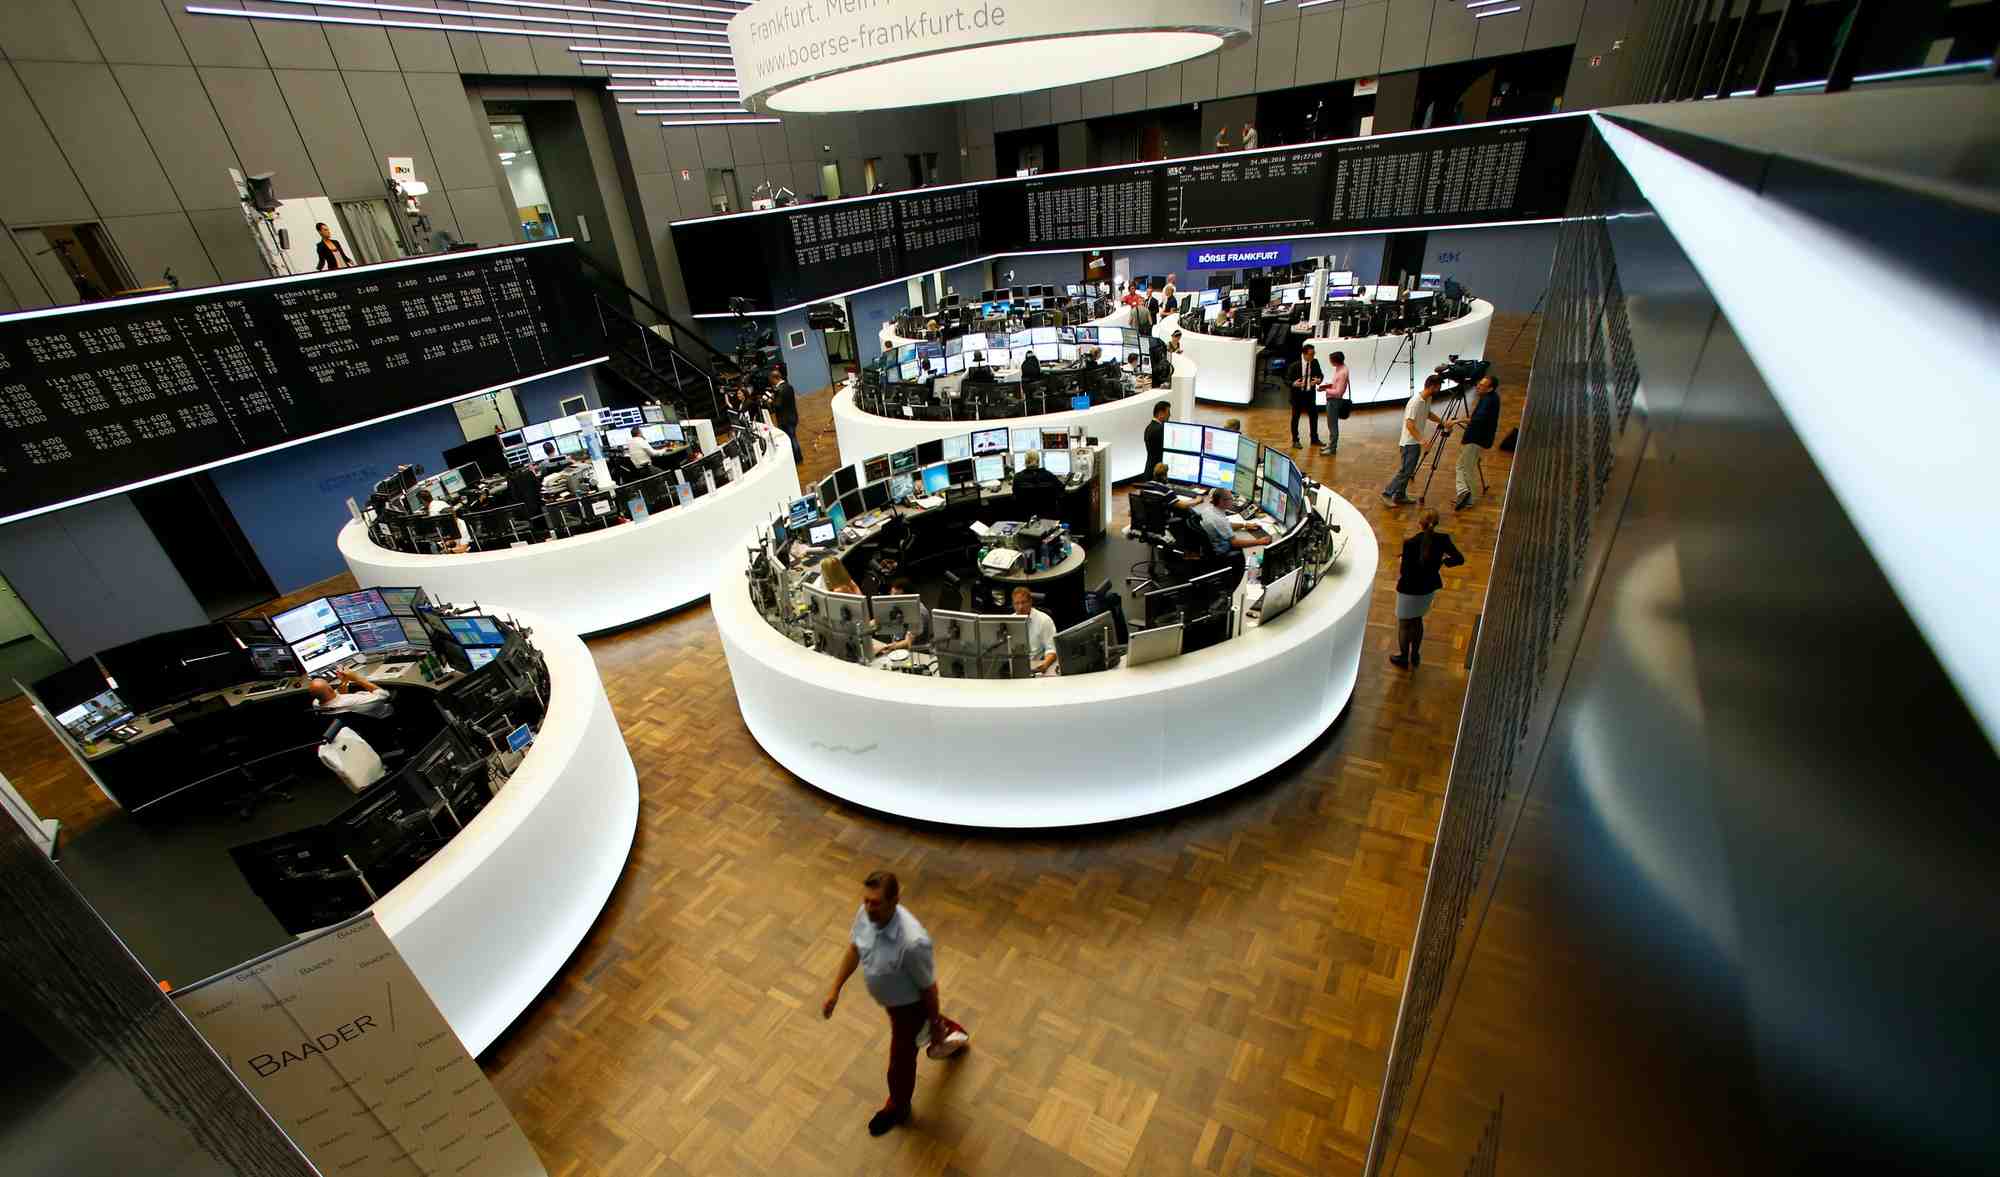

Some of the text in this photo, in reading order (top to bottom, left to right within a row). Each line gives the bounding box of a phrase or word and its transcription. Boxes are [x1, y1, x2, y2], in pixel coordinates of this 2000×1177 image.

[750, 3, 820, 44] Frankfurt.
[755, 3, 1005, 78] www.boerse-frankfurt.de
[1198, 251, 1278, 263] BÖRSE FRANKFURT
[247, 1014, 377, 1078] BAADER
